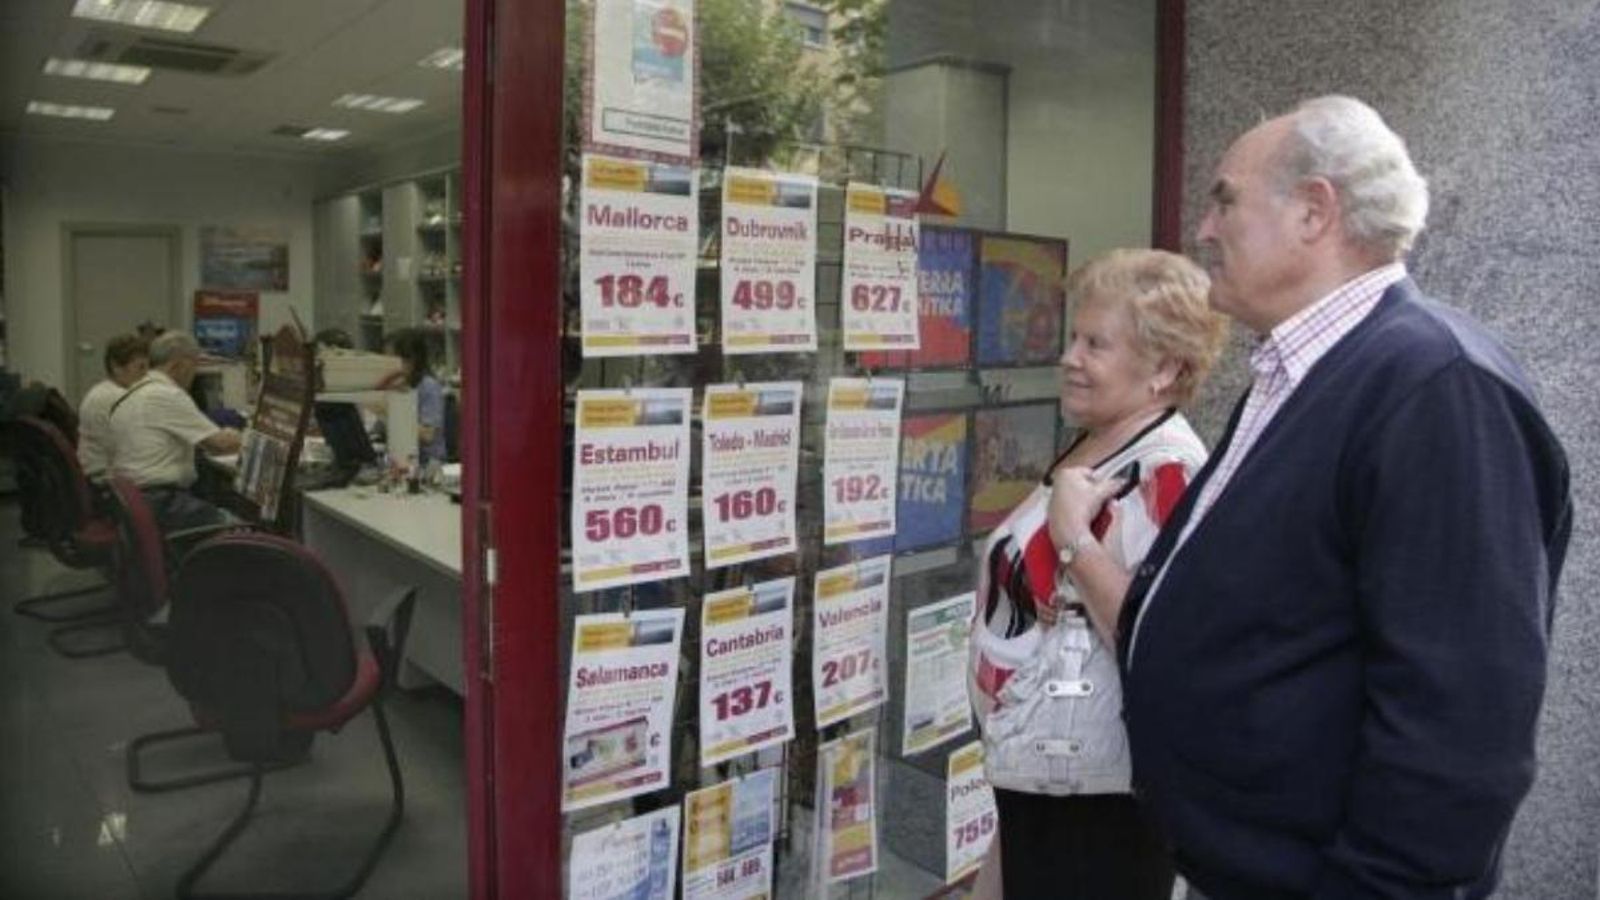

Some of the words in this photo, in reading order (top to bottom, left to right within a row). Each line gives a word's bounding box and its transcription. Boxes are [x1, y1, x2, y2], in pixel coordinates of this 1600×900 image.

[587, 203, 689, 232] Mallorca
[727, 216, 808, 241] Dubrovnik
[580, 438, 679, 466] Estambul
[709, 431, 745, 451] Toledo
[754, 428, 791, 448] Madrid
[819, 599, 882, 629] Valencia
[706, 625, 785, 658] Cantabria
[576, 661, 669, 689] Salamanca
